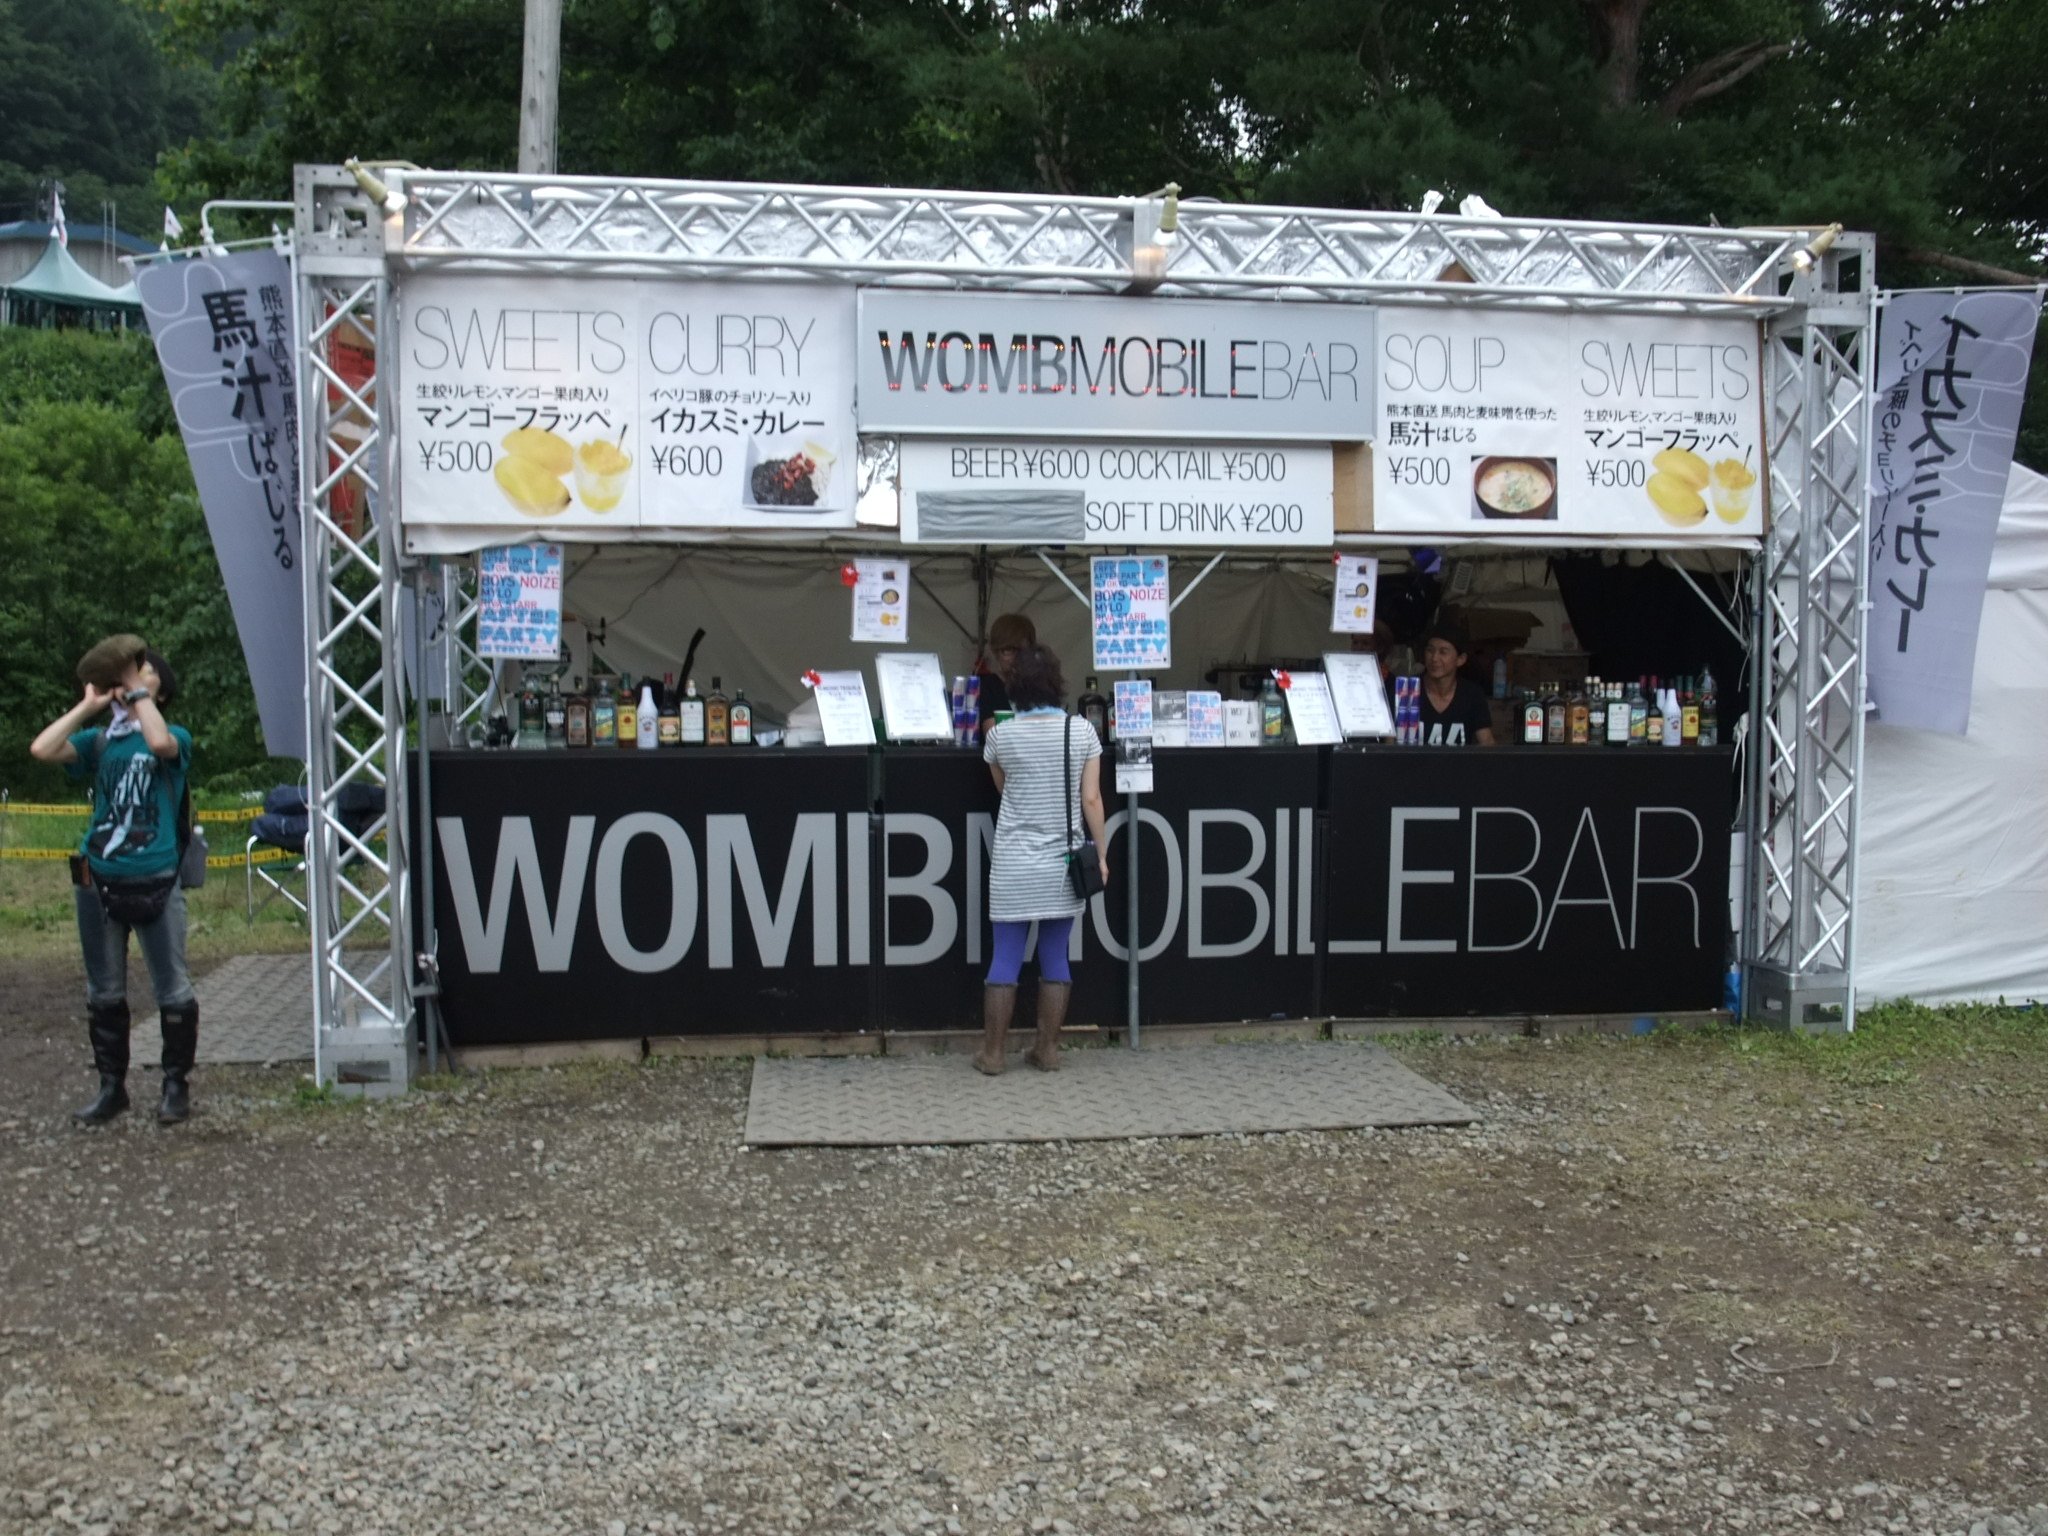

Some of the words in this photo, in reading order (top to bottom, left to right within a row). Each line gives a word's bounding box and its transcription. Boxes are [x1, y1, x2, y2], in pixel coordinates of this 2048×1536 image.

[413, 305, 626, 374] SWEETS
[648, 311, 816, 377] CURRY
[1384, 333, 1505, 393] SOUP
[1580, 340, 1750, 401] SWEETS
[417, 402, 612, 432] マンゴーフラッペ
[650, 406, 825, 436] イカスミ・カレー
[1584, 425, 1740, 453] マンゴーフラッペ
[419, 441, 493, 473] ¥500
[651, 445, 723, 476] ¥600
[1388, 456, 1450, 486] ¥500
[1586, 459, 1646, 489] ¥500
[1084, 500, 1154, 532] SOFT
[481, 575, 516, 587] BOYS
[520, 575, 560, 590] NOIZE
[1094, 589, 1126, 602] BOYS
[1129, 588, 1166, 601] NOIZE
[480, 625, 558, 645] PARTY
[1096, 638, 1167, 655] PARTY
